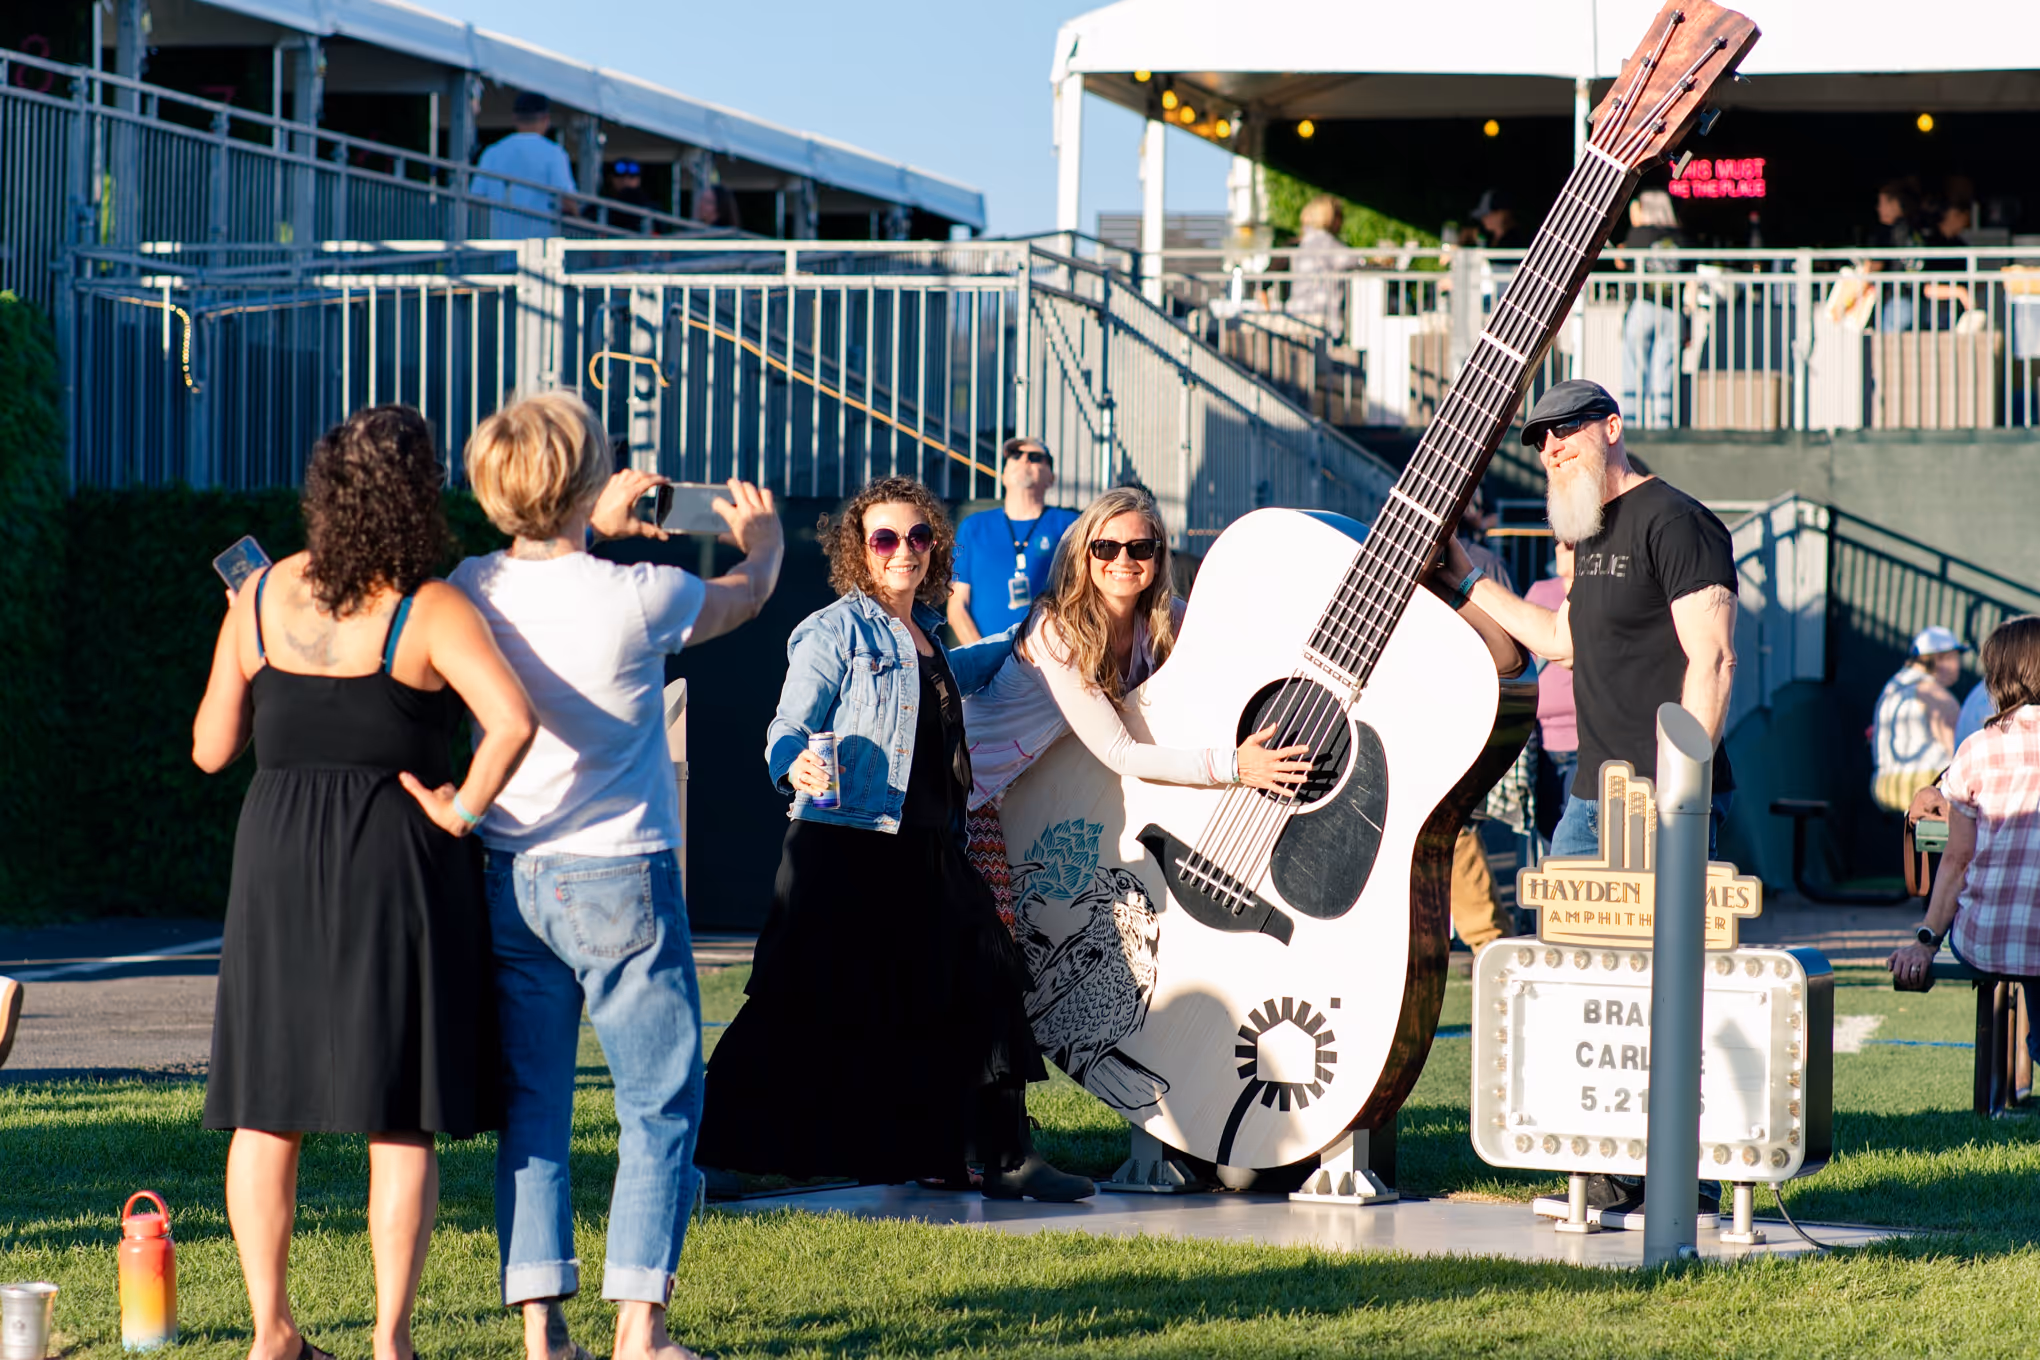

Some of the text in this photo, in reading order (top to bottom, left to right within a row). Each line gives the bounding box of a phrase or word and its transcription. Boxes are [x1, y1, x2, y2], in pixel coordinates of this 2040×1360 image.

[1715, 158, 1766, 180] MUST
[1719, 179, 1766, 198] PLACE
[1528, 878, 1641, 905] HAYDEN
[1549, 910, 1726, 930] AMPHITHER
